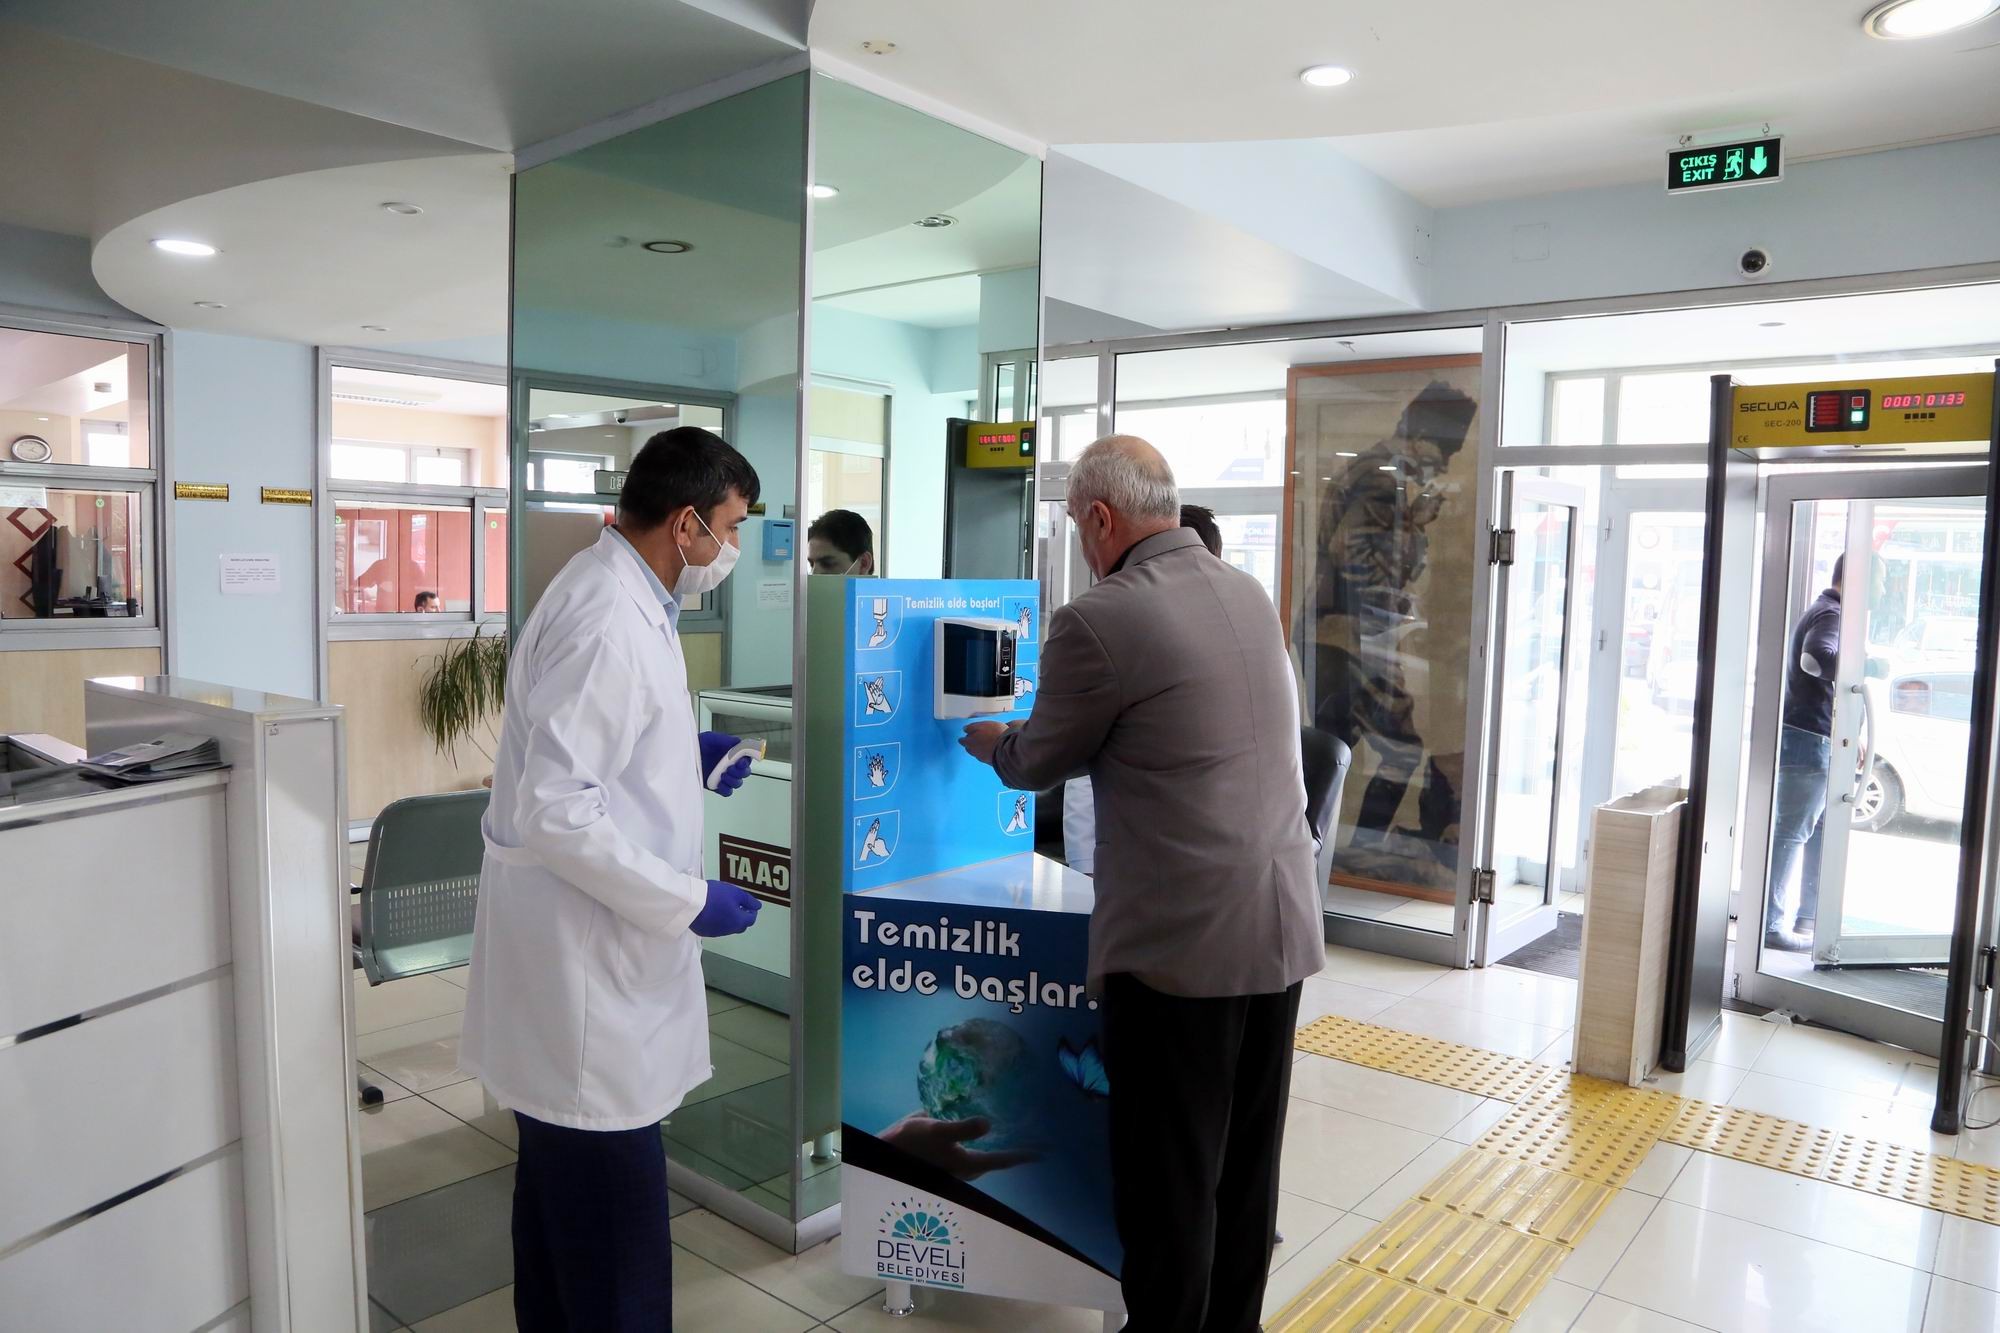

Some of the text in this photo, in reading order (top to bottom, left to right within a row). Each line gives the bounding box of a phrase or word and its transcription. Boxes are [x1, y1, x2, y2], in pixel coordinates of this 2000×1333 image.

[1680, 154, 1717, 170] ÇIKIŞ
[1682, 168, 1714, 182] EXIT
[1740, 401, 1799, 413] SECUDA
[1764, 419, 1802, 428] SEC-200
[905, 597, 1000, 611] Temizlik elde başlar!
[853, 910, 1020, 957] Temizlik
[852, 957, 1098, 1014] elde başlar.
